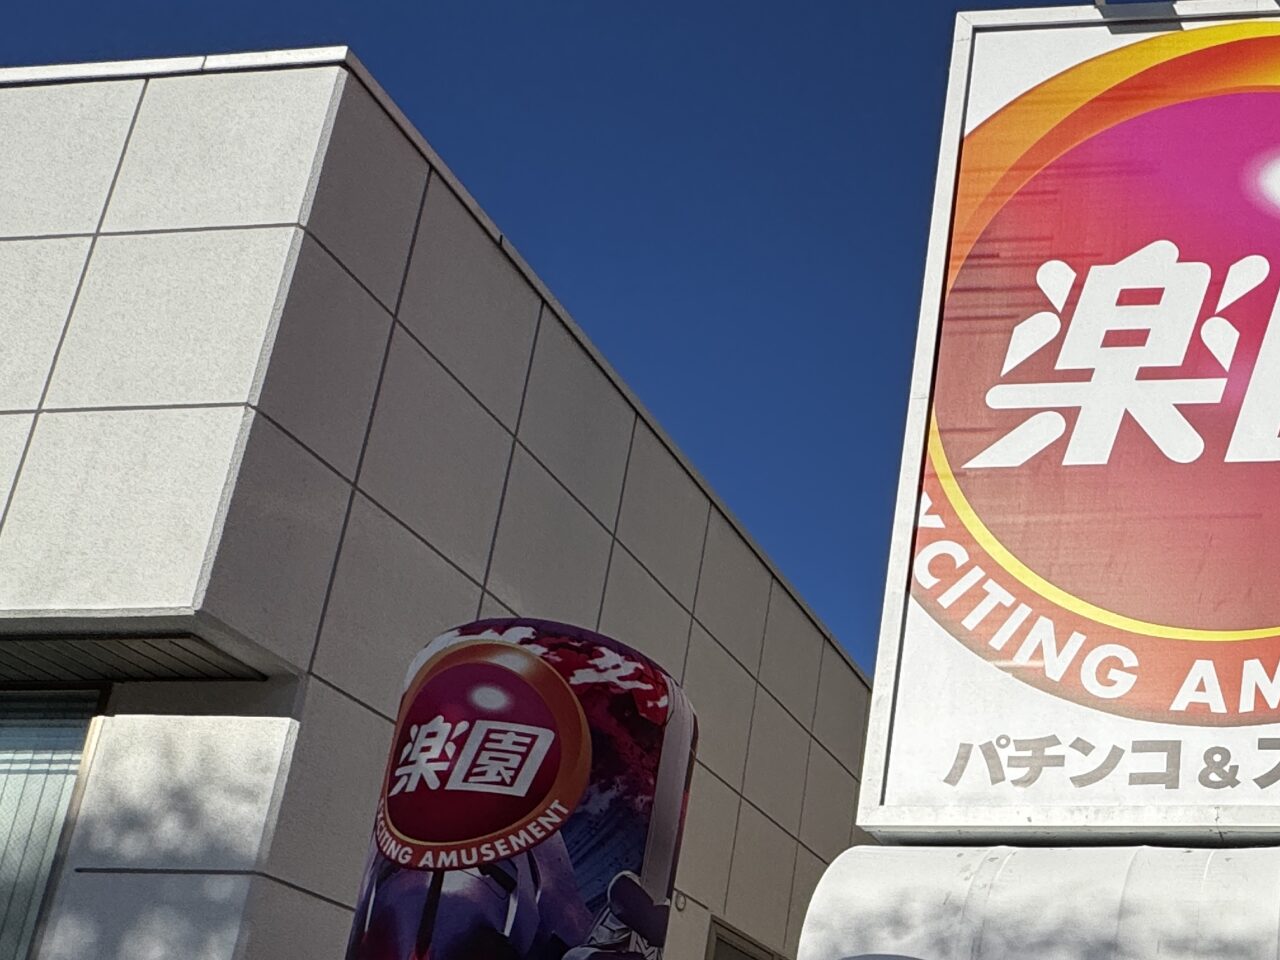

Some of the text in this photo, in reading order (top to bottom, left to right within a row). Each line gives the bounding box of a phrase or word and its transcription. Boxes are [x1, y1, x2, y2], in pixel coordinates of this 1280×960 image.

[388, 715, 556, 798] 楽園
[943, 733, 1183, 790] パチンコ
[1198, 745, 1242, 790] &
[418, 799, 569, 868] AMUSEMENT
